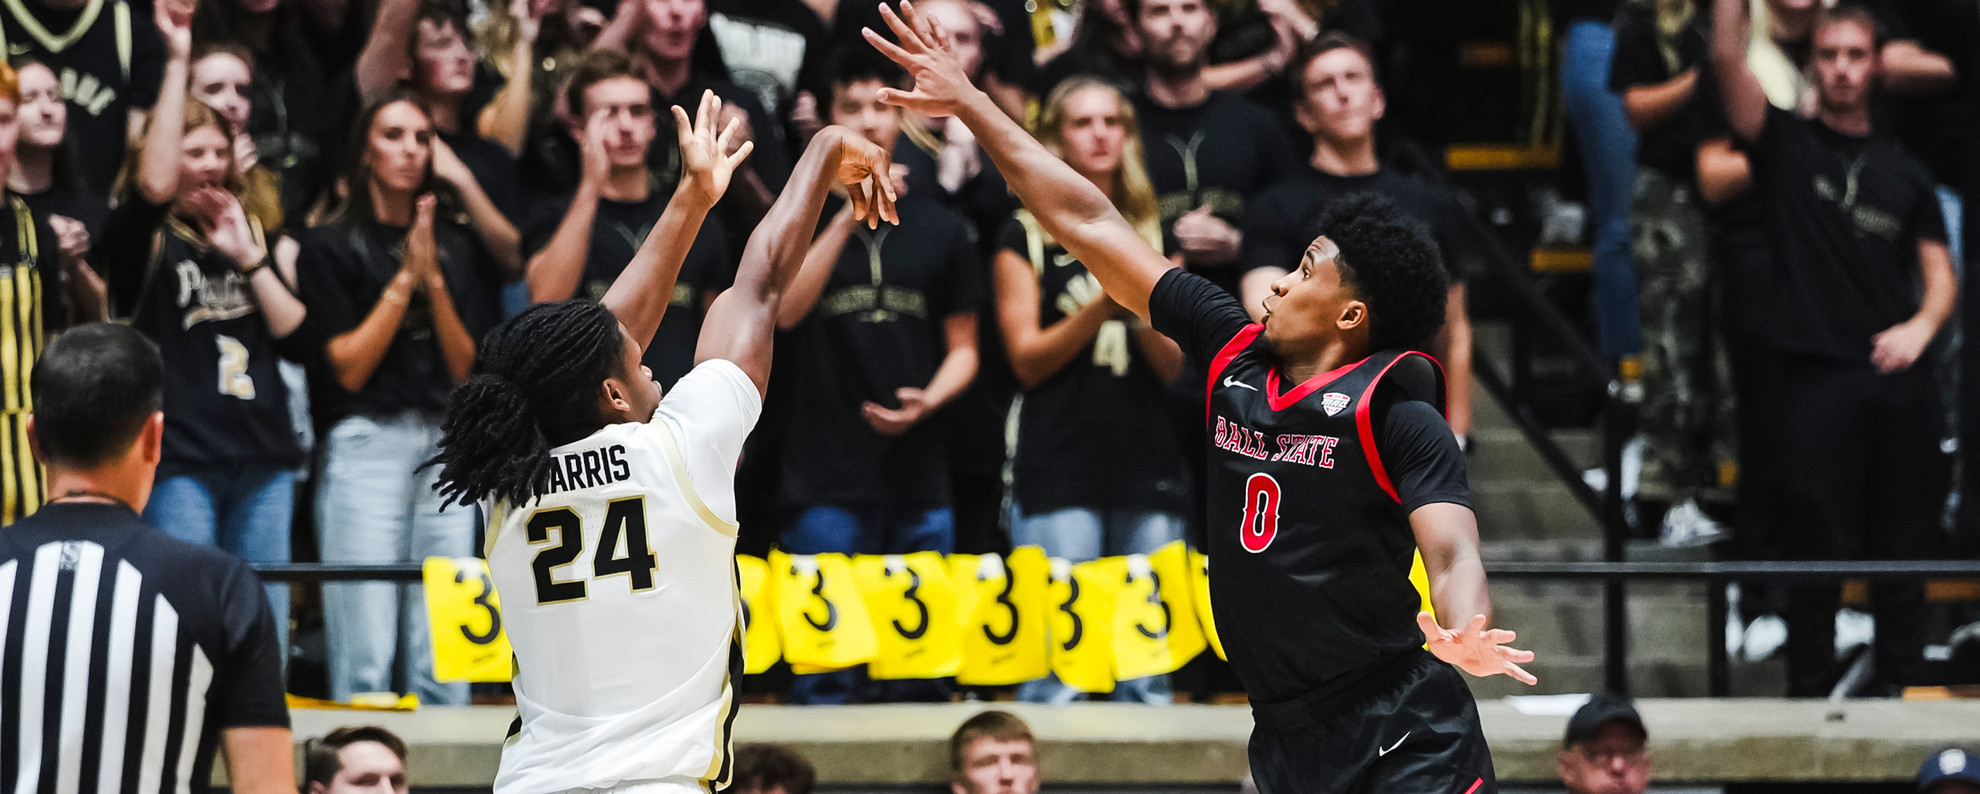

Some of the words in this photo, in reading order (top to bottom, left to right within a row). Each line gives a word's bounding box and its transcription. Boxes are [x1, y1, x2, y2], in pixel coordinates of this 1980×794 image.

[215, 333, 256, 400] 2
[1093, 319, 1130, 377] 4
[532, 444, 631, 496] ARRIS
[1214, 415, 1268, 461] BALL
[1271, 434, 1340, 470] STATE
[1240, 472, 1282, 554] 0
[524, 494, 660, 606] 24
[454, 570, 501, 645] 3
[791, 566, 837, 632] 3
[884, 566, 929, 640] 3
[978, 565, 1019, 646] 3
[1048, 575, 1083, 651] 3
[1126, 569, 1172, 639] 3
